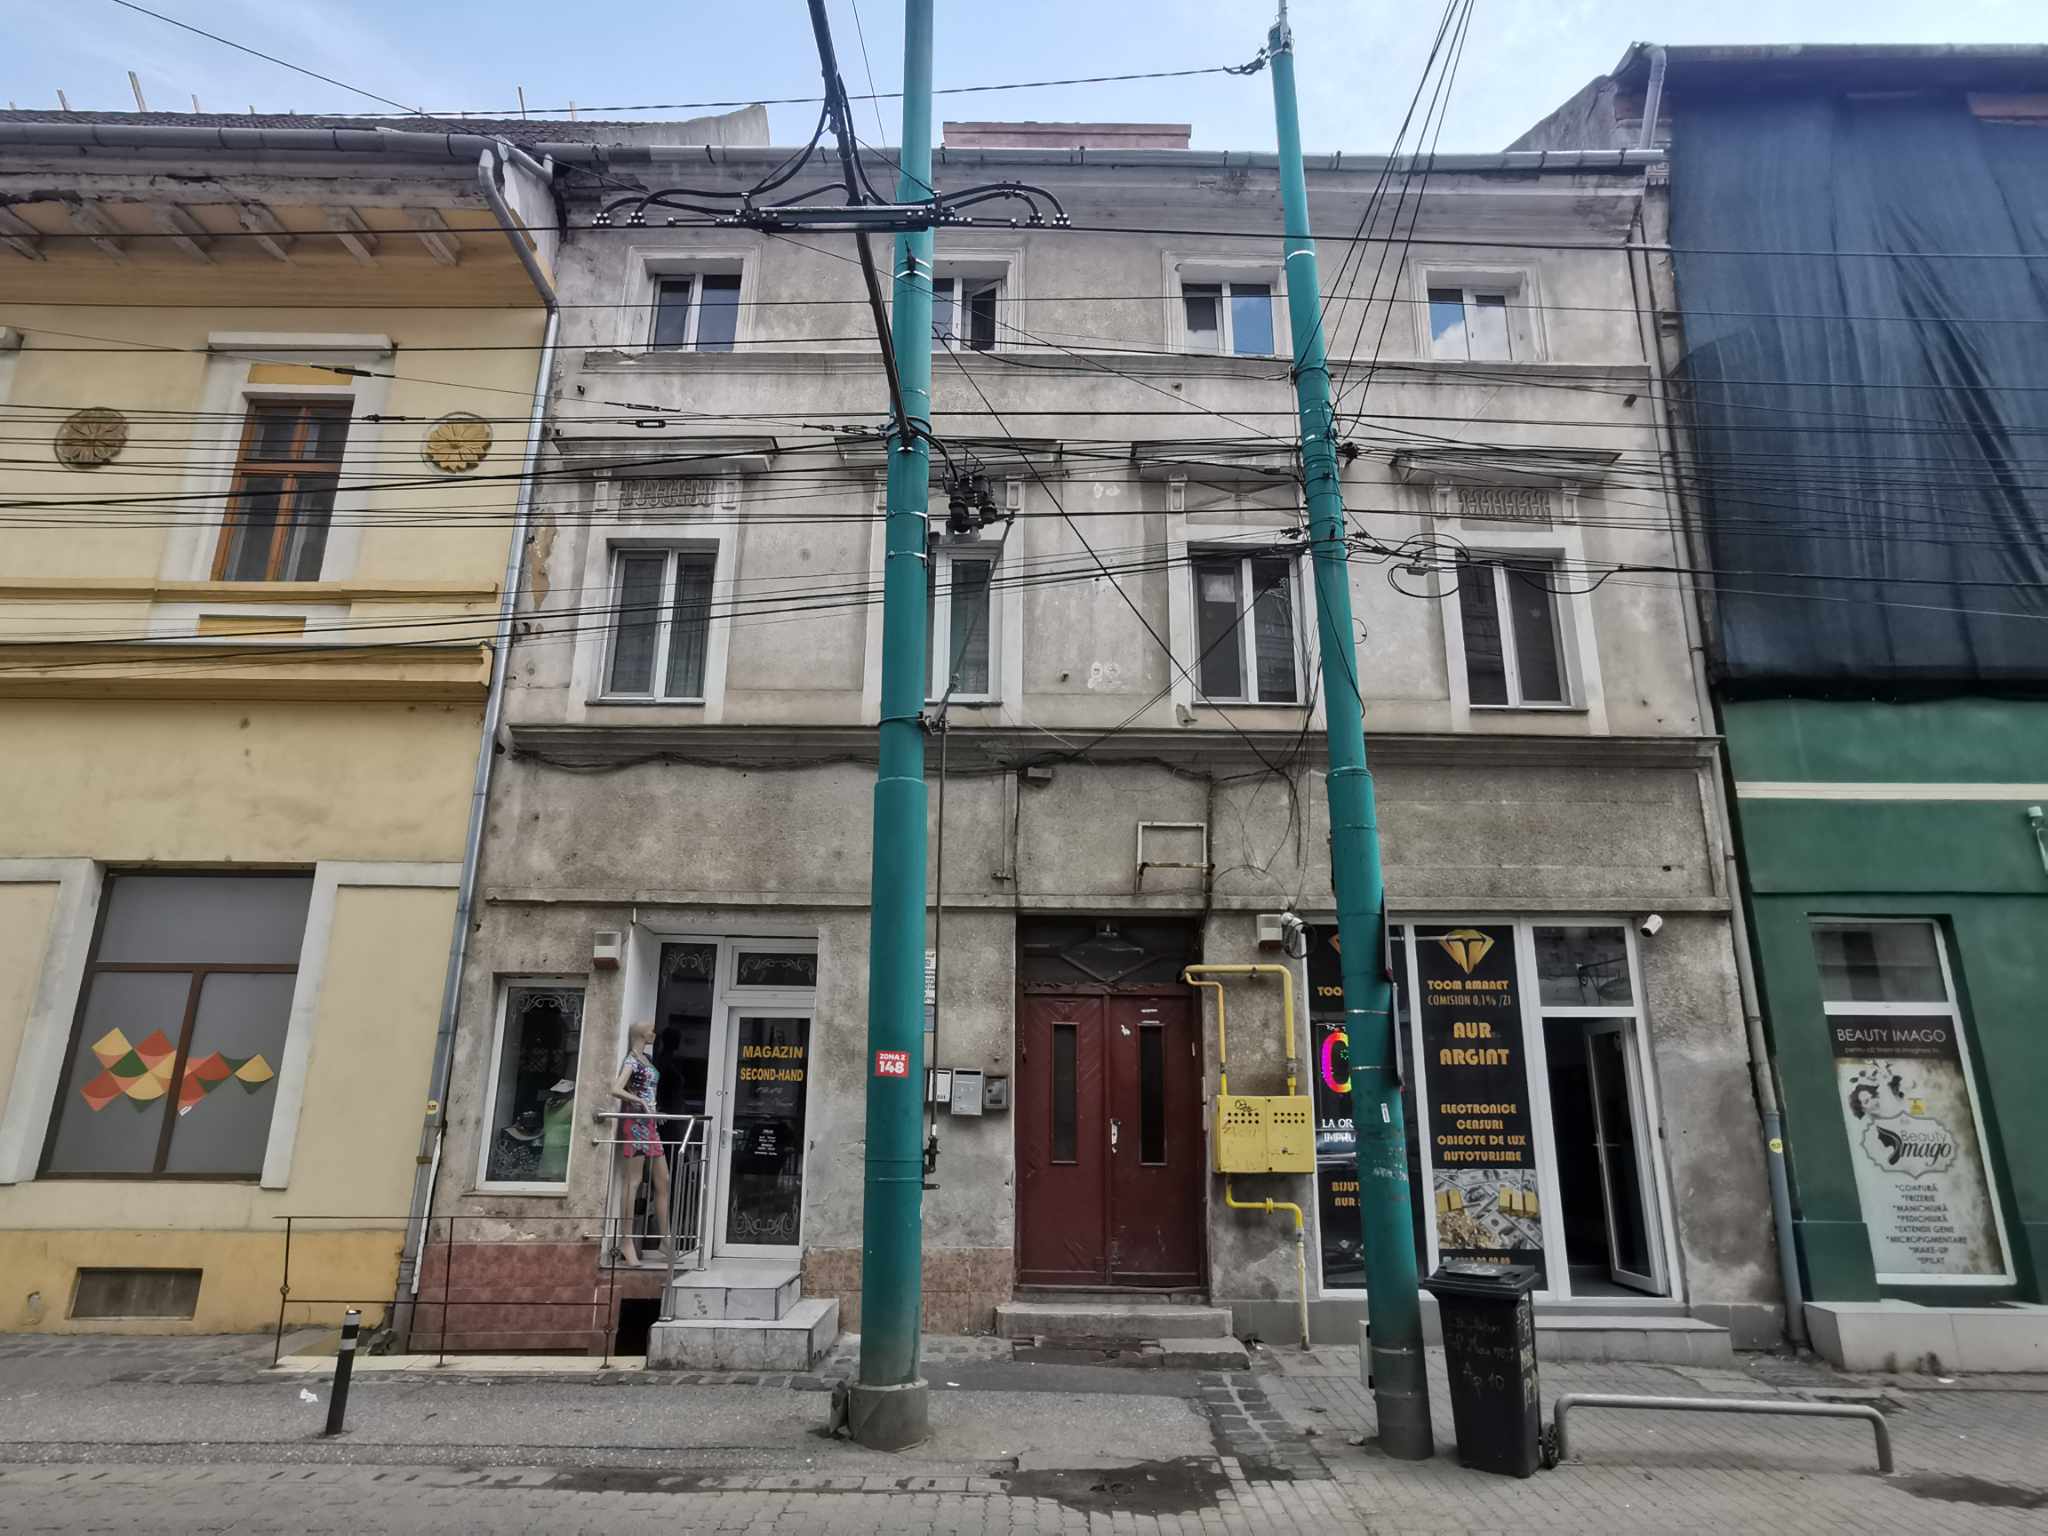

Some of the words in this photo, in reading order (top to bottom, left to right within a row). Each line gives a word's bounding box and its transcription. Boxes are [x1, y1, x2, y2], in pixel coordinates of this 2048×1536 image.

[1317, 986, 1344, 996] TOO
[1427, 980, 1462, 990] TOOM
[1465, 980, 1509, 990] AMANET
[1427, 994, 1471, 1006] COMISION
[1453, 1022, 1492, 1038] AUR
[1836, 1028, 1888, 1042] BEAUTY
[1892, 1029, 1946, 1042] IMAGO
[742, 1045, 804, 1059] MAGAZIN
[1440, 1048, 1510, 1065] ARGINT
[879, 1060, 905, 1074] 148
[740, 1067, 804, 1081] SECOND-HAND
[1441, 1104, 1517, 1114] ELECTRONICE
[1322, 1118, 1335, 1128] LA
[1437, 1135, 1486, 1145] OBIECTE
[1489, 1135, 1504, 1145] DE
[1507, 1135, 1527, 1145] LUX
[1443, 1151, 1521, 1161] AUTOTURISME
